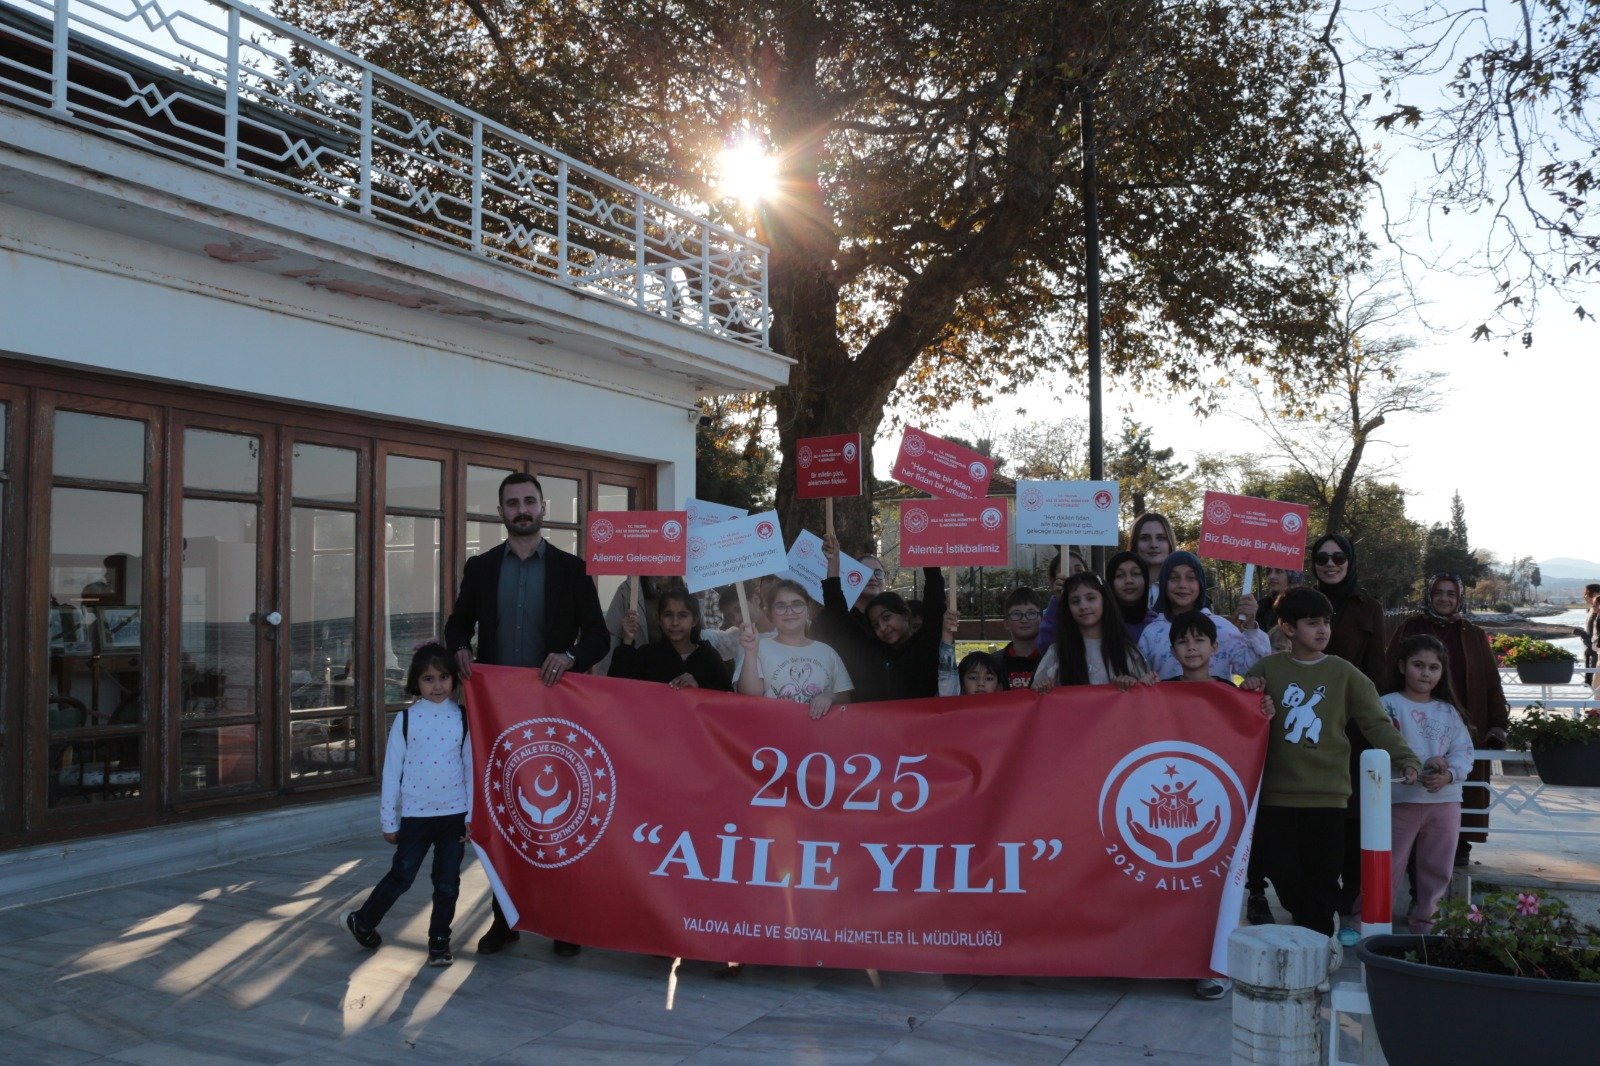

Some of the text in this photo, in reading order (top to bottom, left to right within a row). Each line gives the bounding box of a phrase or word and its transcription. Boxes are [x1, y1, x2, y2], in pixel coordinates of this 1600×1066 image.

[901, 467, 914, 478] her
[915, 473, 934, 486] fidan
[934, 480, 944, 490] bir
[911, 461, 972, 493] "Her aile bir fidan,
[907, 543, 1000, 554] Ailemiz İstikbalimiz
[1204, 532, 1300, 556] Biz Büyük Bir Aileyiz
[592, 553, 681, 565] Ailemiz Geleceğimiz
[520, 745, 538, 759] AİLE
[538, 744, 550, 752] VE
[550, 744, 577, 764] SOSYAL
[575, 761, 590, 809] HİZMETLER
[750, 747, 929, 812] 2025
[550, 808, 586, 842] BAKANLIĞI
[1105, 843, 1147, 883] 2025
[1155, 875, 1203, 891] AİLE
[683, 917, 1002, 947] YALOVA AİLE VE SOSYAL HİZMETLER İL MÜDÜRLÜĞÜ
